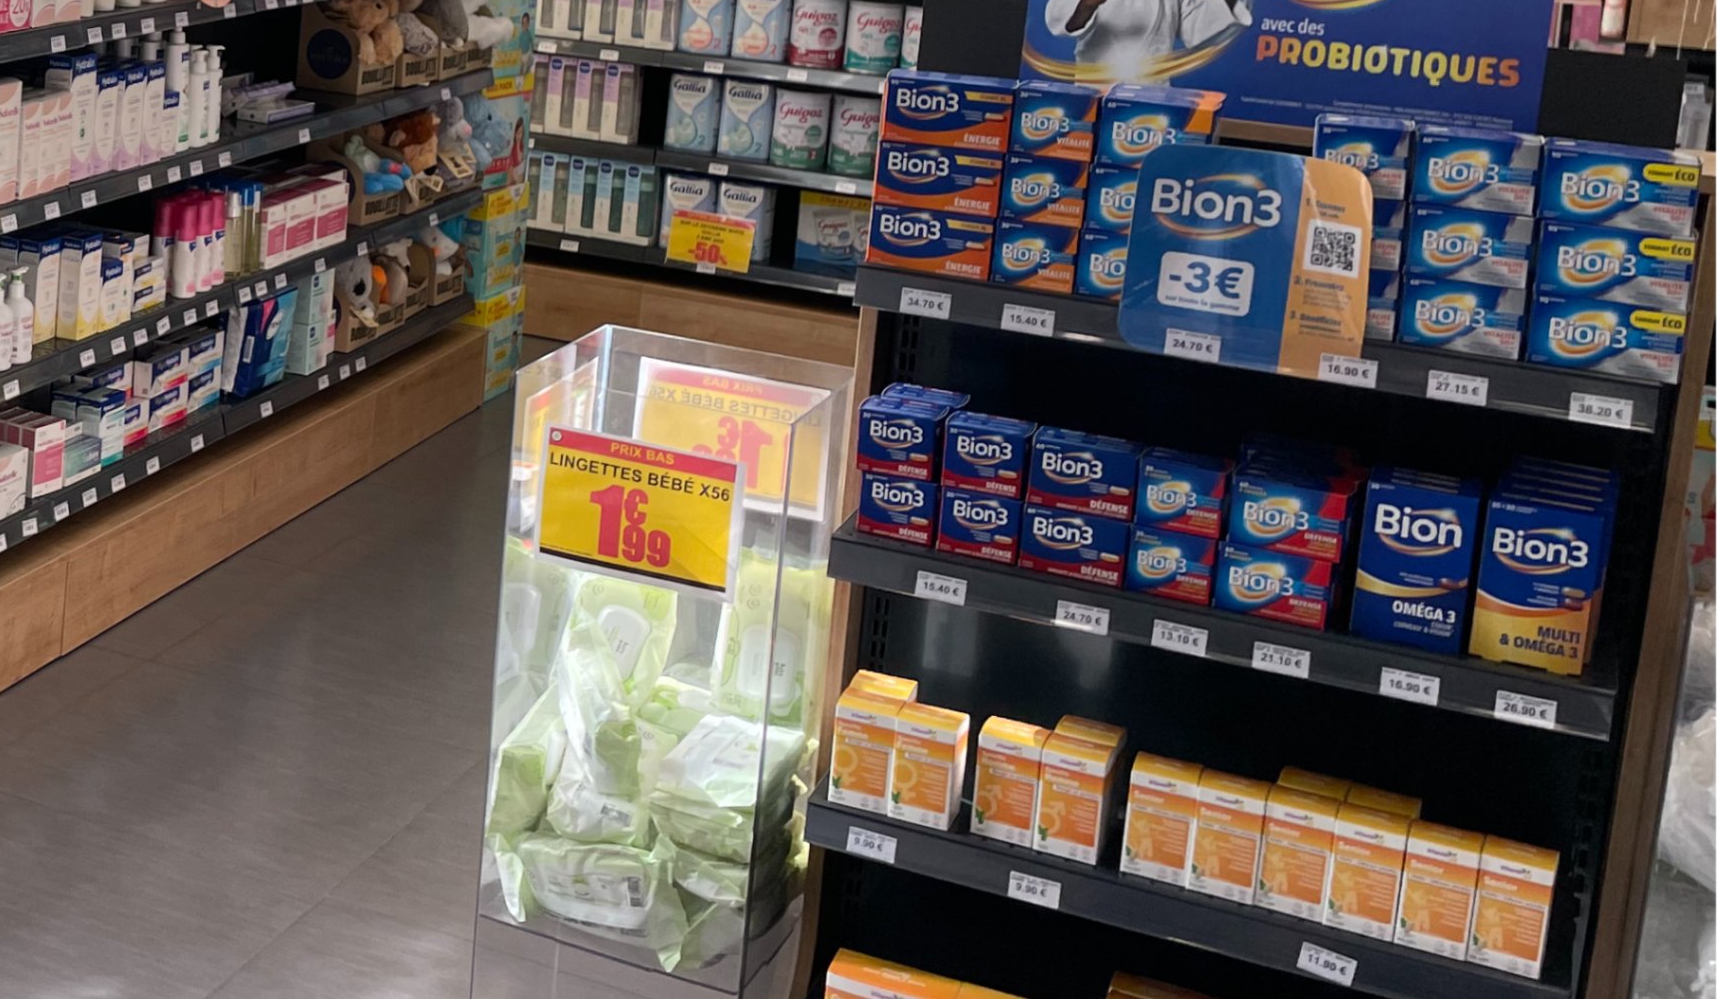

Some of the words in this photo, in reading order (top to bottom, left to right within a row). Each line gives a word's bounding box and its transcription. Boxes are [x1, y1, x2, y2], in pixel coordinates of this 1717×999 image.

[1261, 17, 1295, 36] avec
[1298, 19, 1325, 37] des
[1255, 36, 1521, 88] PROBIOTIQUES
[896, 88, 959, 112] Bion3
[1021, 112, 1070, 132] Bion3
[964, 133, 1001, 146] ÉNERGIE
[887, 151, 950, 177] Bion3
[1428, 158, 1499, 184] Bion3
[1675, 168, 1696, 182] ÉCO
[1011, 178, 1060, 199] Bion3
[1561, 172, 1640, 202] Bion3
[954, 197, 991, 211] ÉNERGIE
[1151, 178, 1282, 228] Bion3
[879, 214, 941, 239] Bion3
[1002, 243, 1051, 263] Bion3
[1422, 230, 1492, 257] Bion3
[1671, 244, 1692, 257] ÉCO
[945, 261, 982, 274] ÉNERGIE
[1558, 245, 1636, 277] Bion3
[1169, 261, 1244, 299] -3€
[938, 302, 944, 310] €
[1415, 300, 1485, 329] Bion3
[1010, 314, 1037, 326] 15.40
[1041, 318, 1046, 328] €
[1662, 316, 1682, 329] ÉCO
[1549, 317, 1627, 349] Bion3
[1173, 339, 1203, 351] 24.70
[1206, 345, 1213, 353] €
[1328, 364, 1358, 376] 16.90
[1362, 369, 1370, 378] €
[1435, 381, 1468, 394] 27.15
[1472, 386, 1479, 397] €
[870, 420, 923, 444] Bion3
[610, 442, 642, 459] PRIX
[646, 450, 675, 465] BAS
[957, 435, 1012, 460] Bion3
[898, 464, 928, 477] DÉFENSE
[1041, 451, 1103, 479] Bion3
[550, 452, 642, 483] LINGETTES
[647, 471, 694, 494] BÉBÉ
[699, 483, 730, 502] X56
[986, 480, 1017, 494] DÉFENSE
[871, 482, 925, 508] Bion3
[1147, 485, 1197, 508] Bion3
[953, 500, 1008, 526] Bion3
[1090, 499, 1129, 515] DÉFENSE
[1244, 501, 1309, 530] Bion3
[1033, 517, 1093, 545] Bion3
[1374, 503, 1463, 548] Bion
[1492, 526, 1589, 569] Bion3
[1080, 565, 1119, 581] DÉFENSE
[1137, 550, 1187, 573] Bion3
[924, 582, 950, 594] 15.40
[953, 587, 959, 596] €
[1229, 566, 1294, 596] Bion3
[1392, 599, 1442, 622] OMÉGA
[1446, 610, 1456, 623] 3
[1193, 637, 1199, 646] €
[1500, 633, 1510, 645] &
[1513, 636, 1565, 657] OMÉGA
[1568, 646, 1579, 659] 3
[1537, 625, 1581, 645] MULTI
[1389, 679, 1420, 693] 16.90
[1423, 685, 1431, 695] €
[1503, 702, 1536, 717] 26.90
[1540, 709, 1547, 719] €
[1308, 954, 1337, 971] 11.90
[1340, 966, 1347, 976] €
